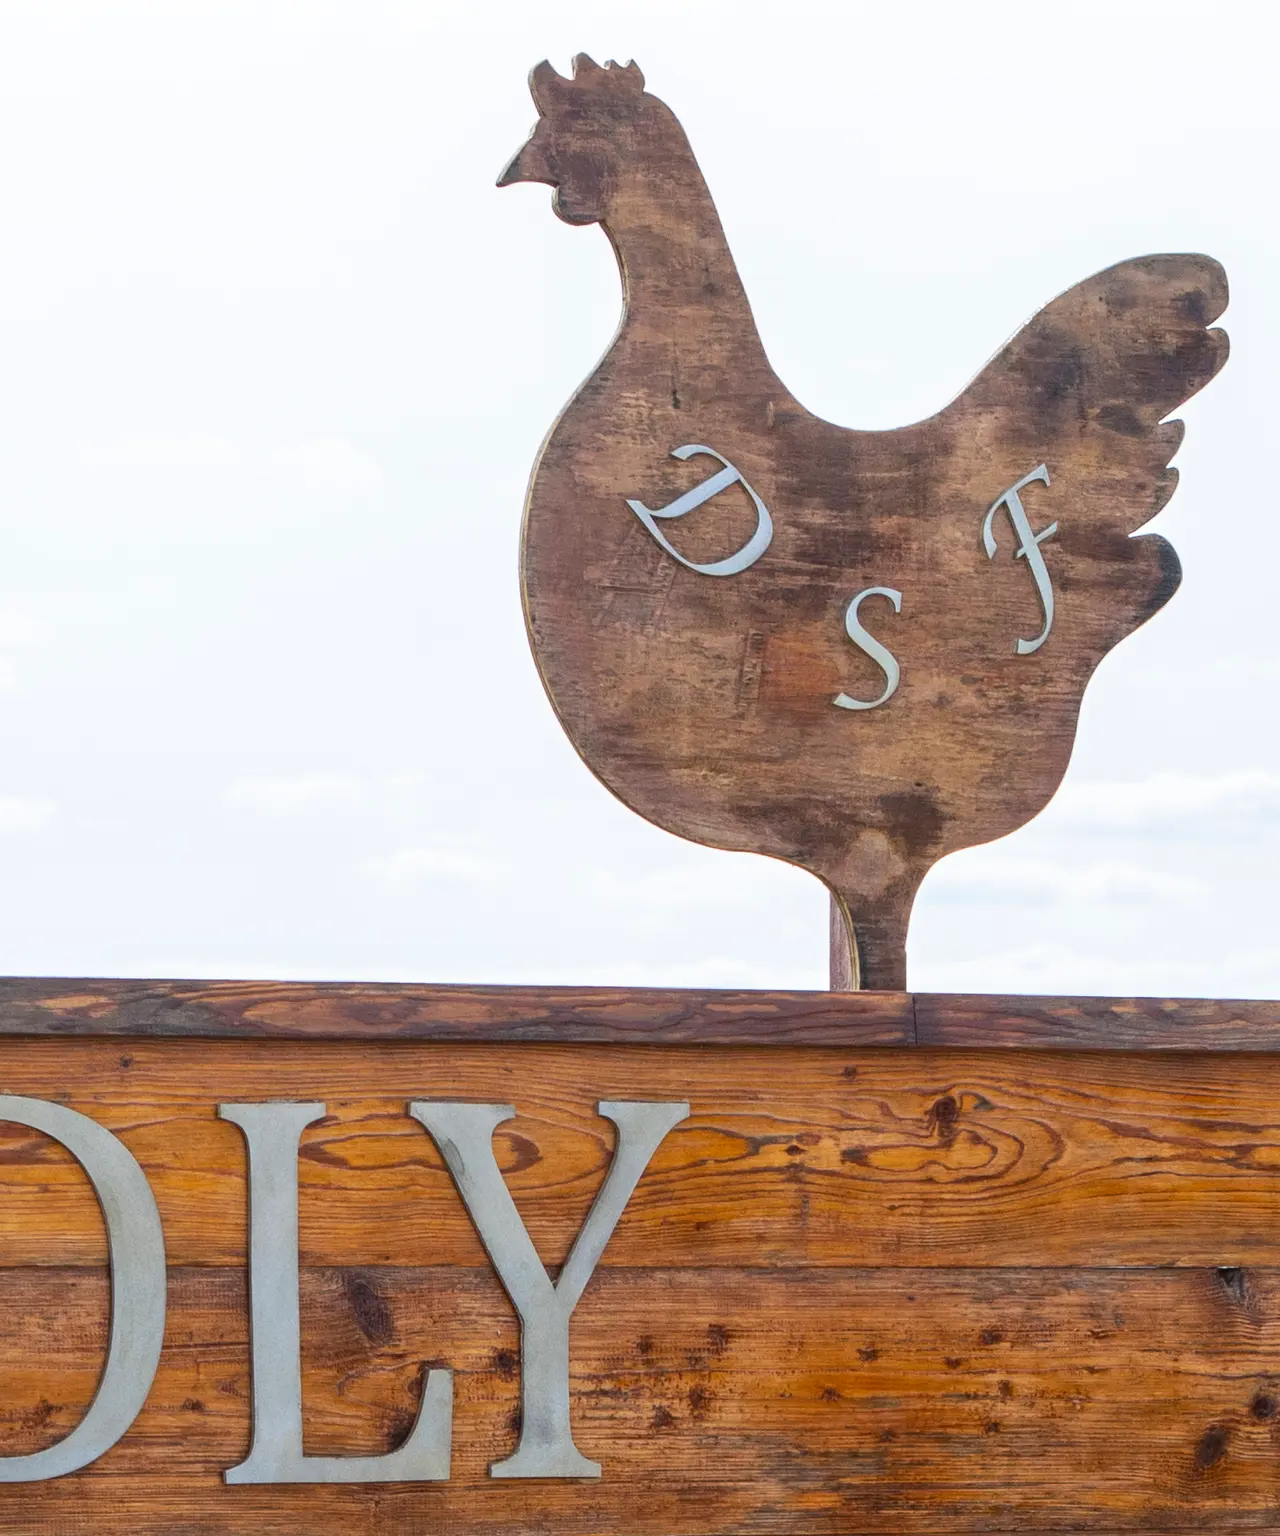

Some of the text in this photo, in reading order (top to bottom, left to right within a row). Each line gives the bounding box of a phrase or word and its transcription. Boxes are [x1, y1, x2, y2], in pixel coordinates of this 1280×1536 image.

[625, 443, 1059, 711] D S F
